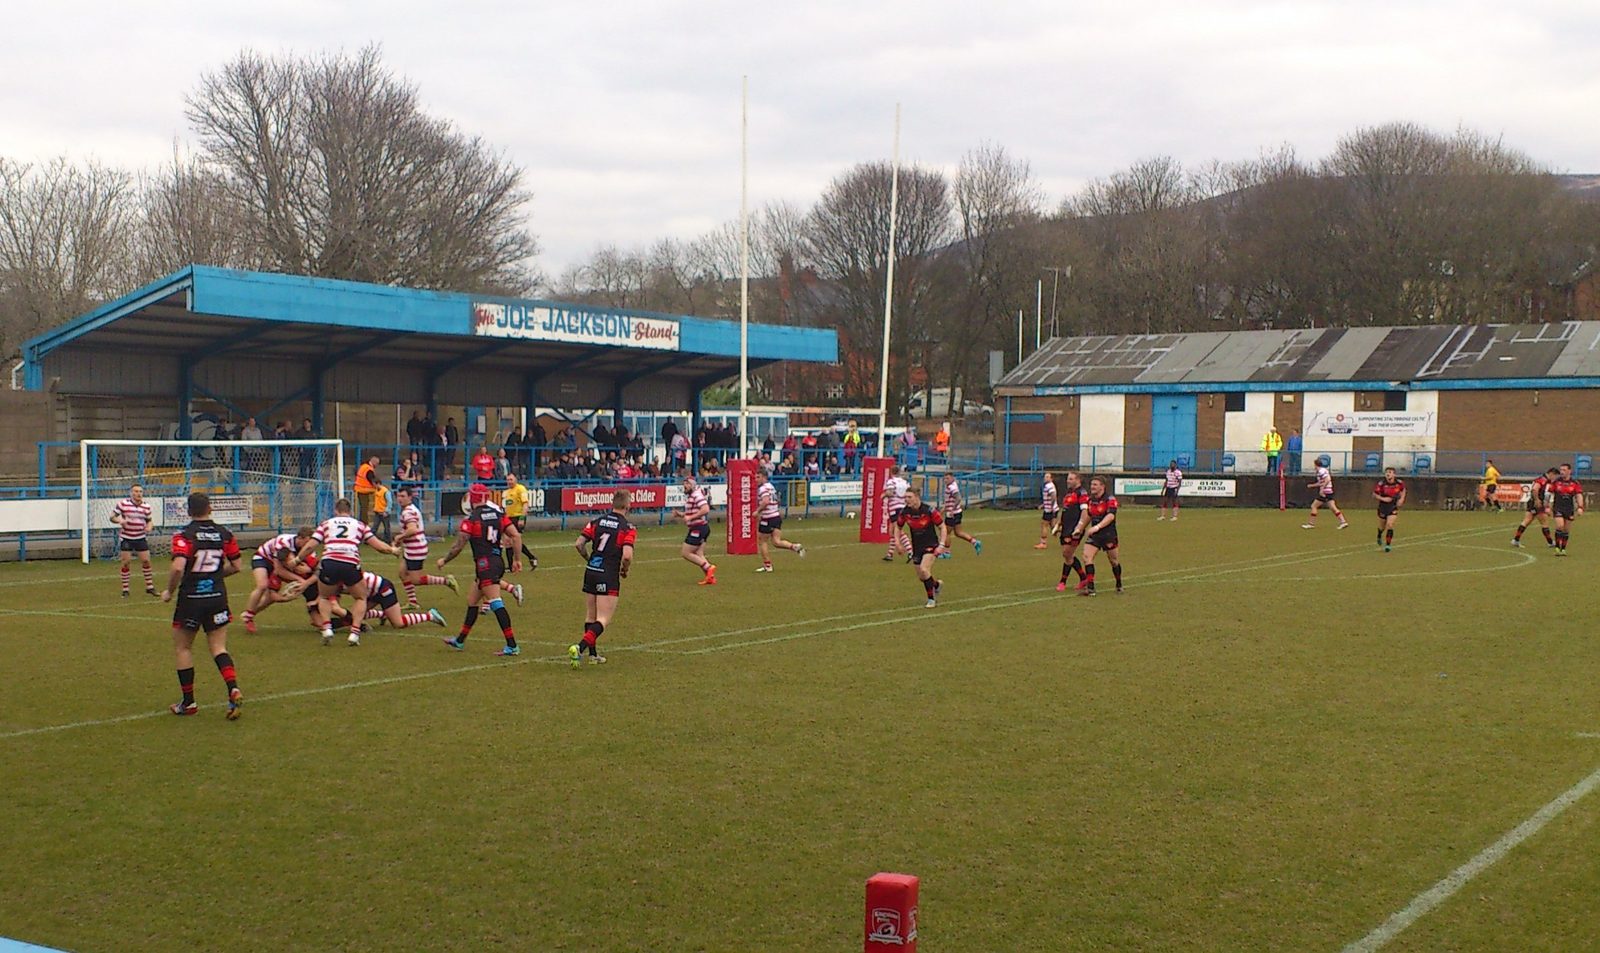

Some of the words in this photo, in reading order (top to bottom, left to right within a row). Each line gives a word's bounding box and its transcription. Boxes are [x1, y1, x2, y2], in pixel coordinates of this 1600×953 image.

[476, 309, 495, 327] The
[496, 305, 535, 330] JOE
[542, 309, 631, 339] JACKSON
[634, 321, 673, 342] Stand
[574, 491, 614, 507] Kingstone
[635, 490, 656, 502] Cider
[741, 476, 751, 503] CIDER
[741, 504, 751, 539] PROPER
[864, 498, 873, 529] PROPER
[335, 525, 349, 539] 2
[597, 533, 611, 552] 1
[191, 549, 224, 573] 15
